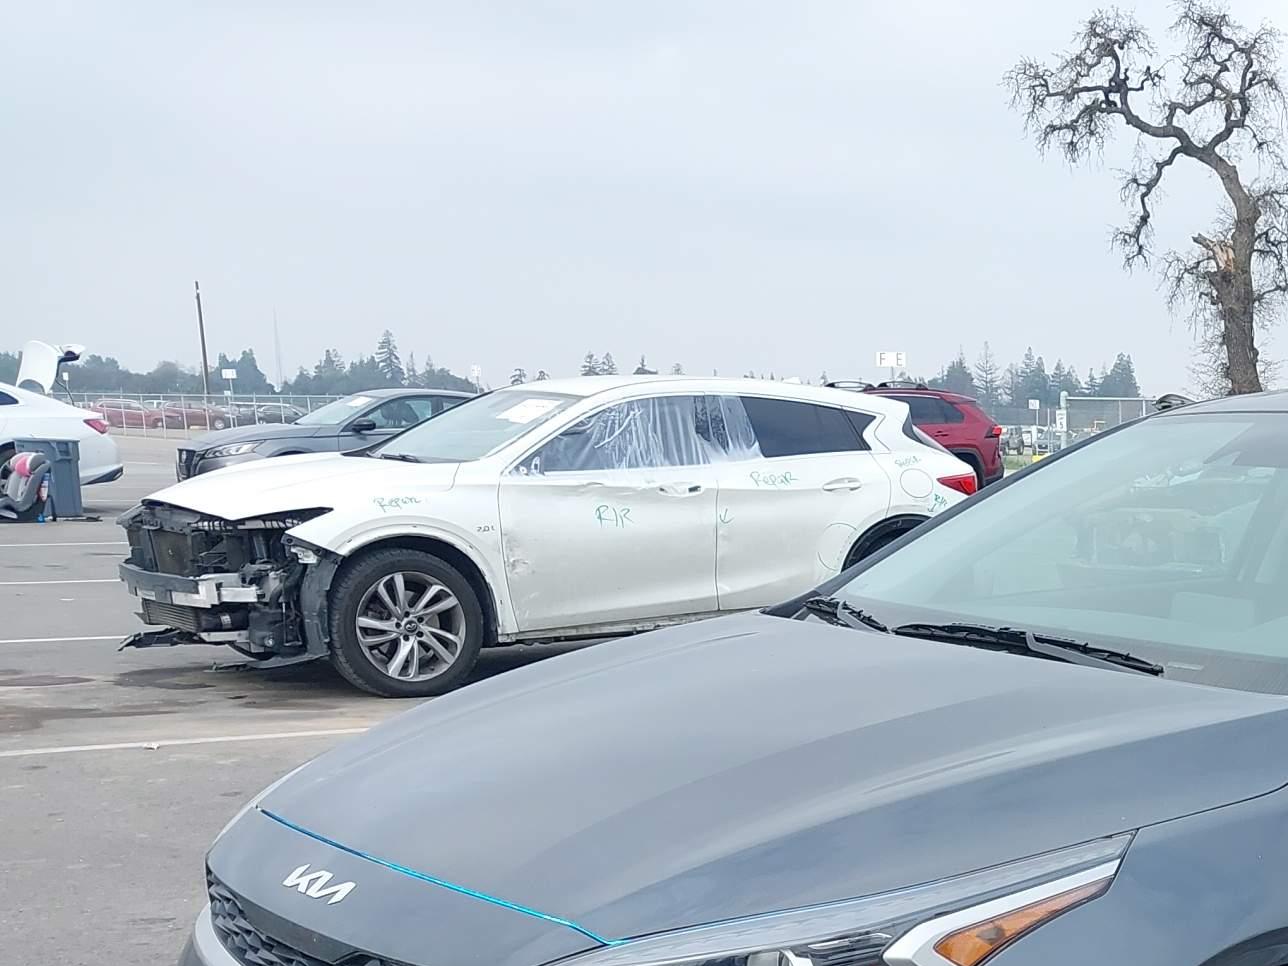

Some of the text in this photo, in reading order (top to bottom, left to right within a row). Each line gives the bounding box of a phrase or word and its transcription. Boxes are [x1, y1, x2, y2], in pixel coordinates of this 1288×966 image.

[879, 352, 904, 367] F E
[594, 504, 634, 529] R/R
[282, 863, 357, 905] KIA
